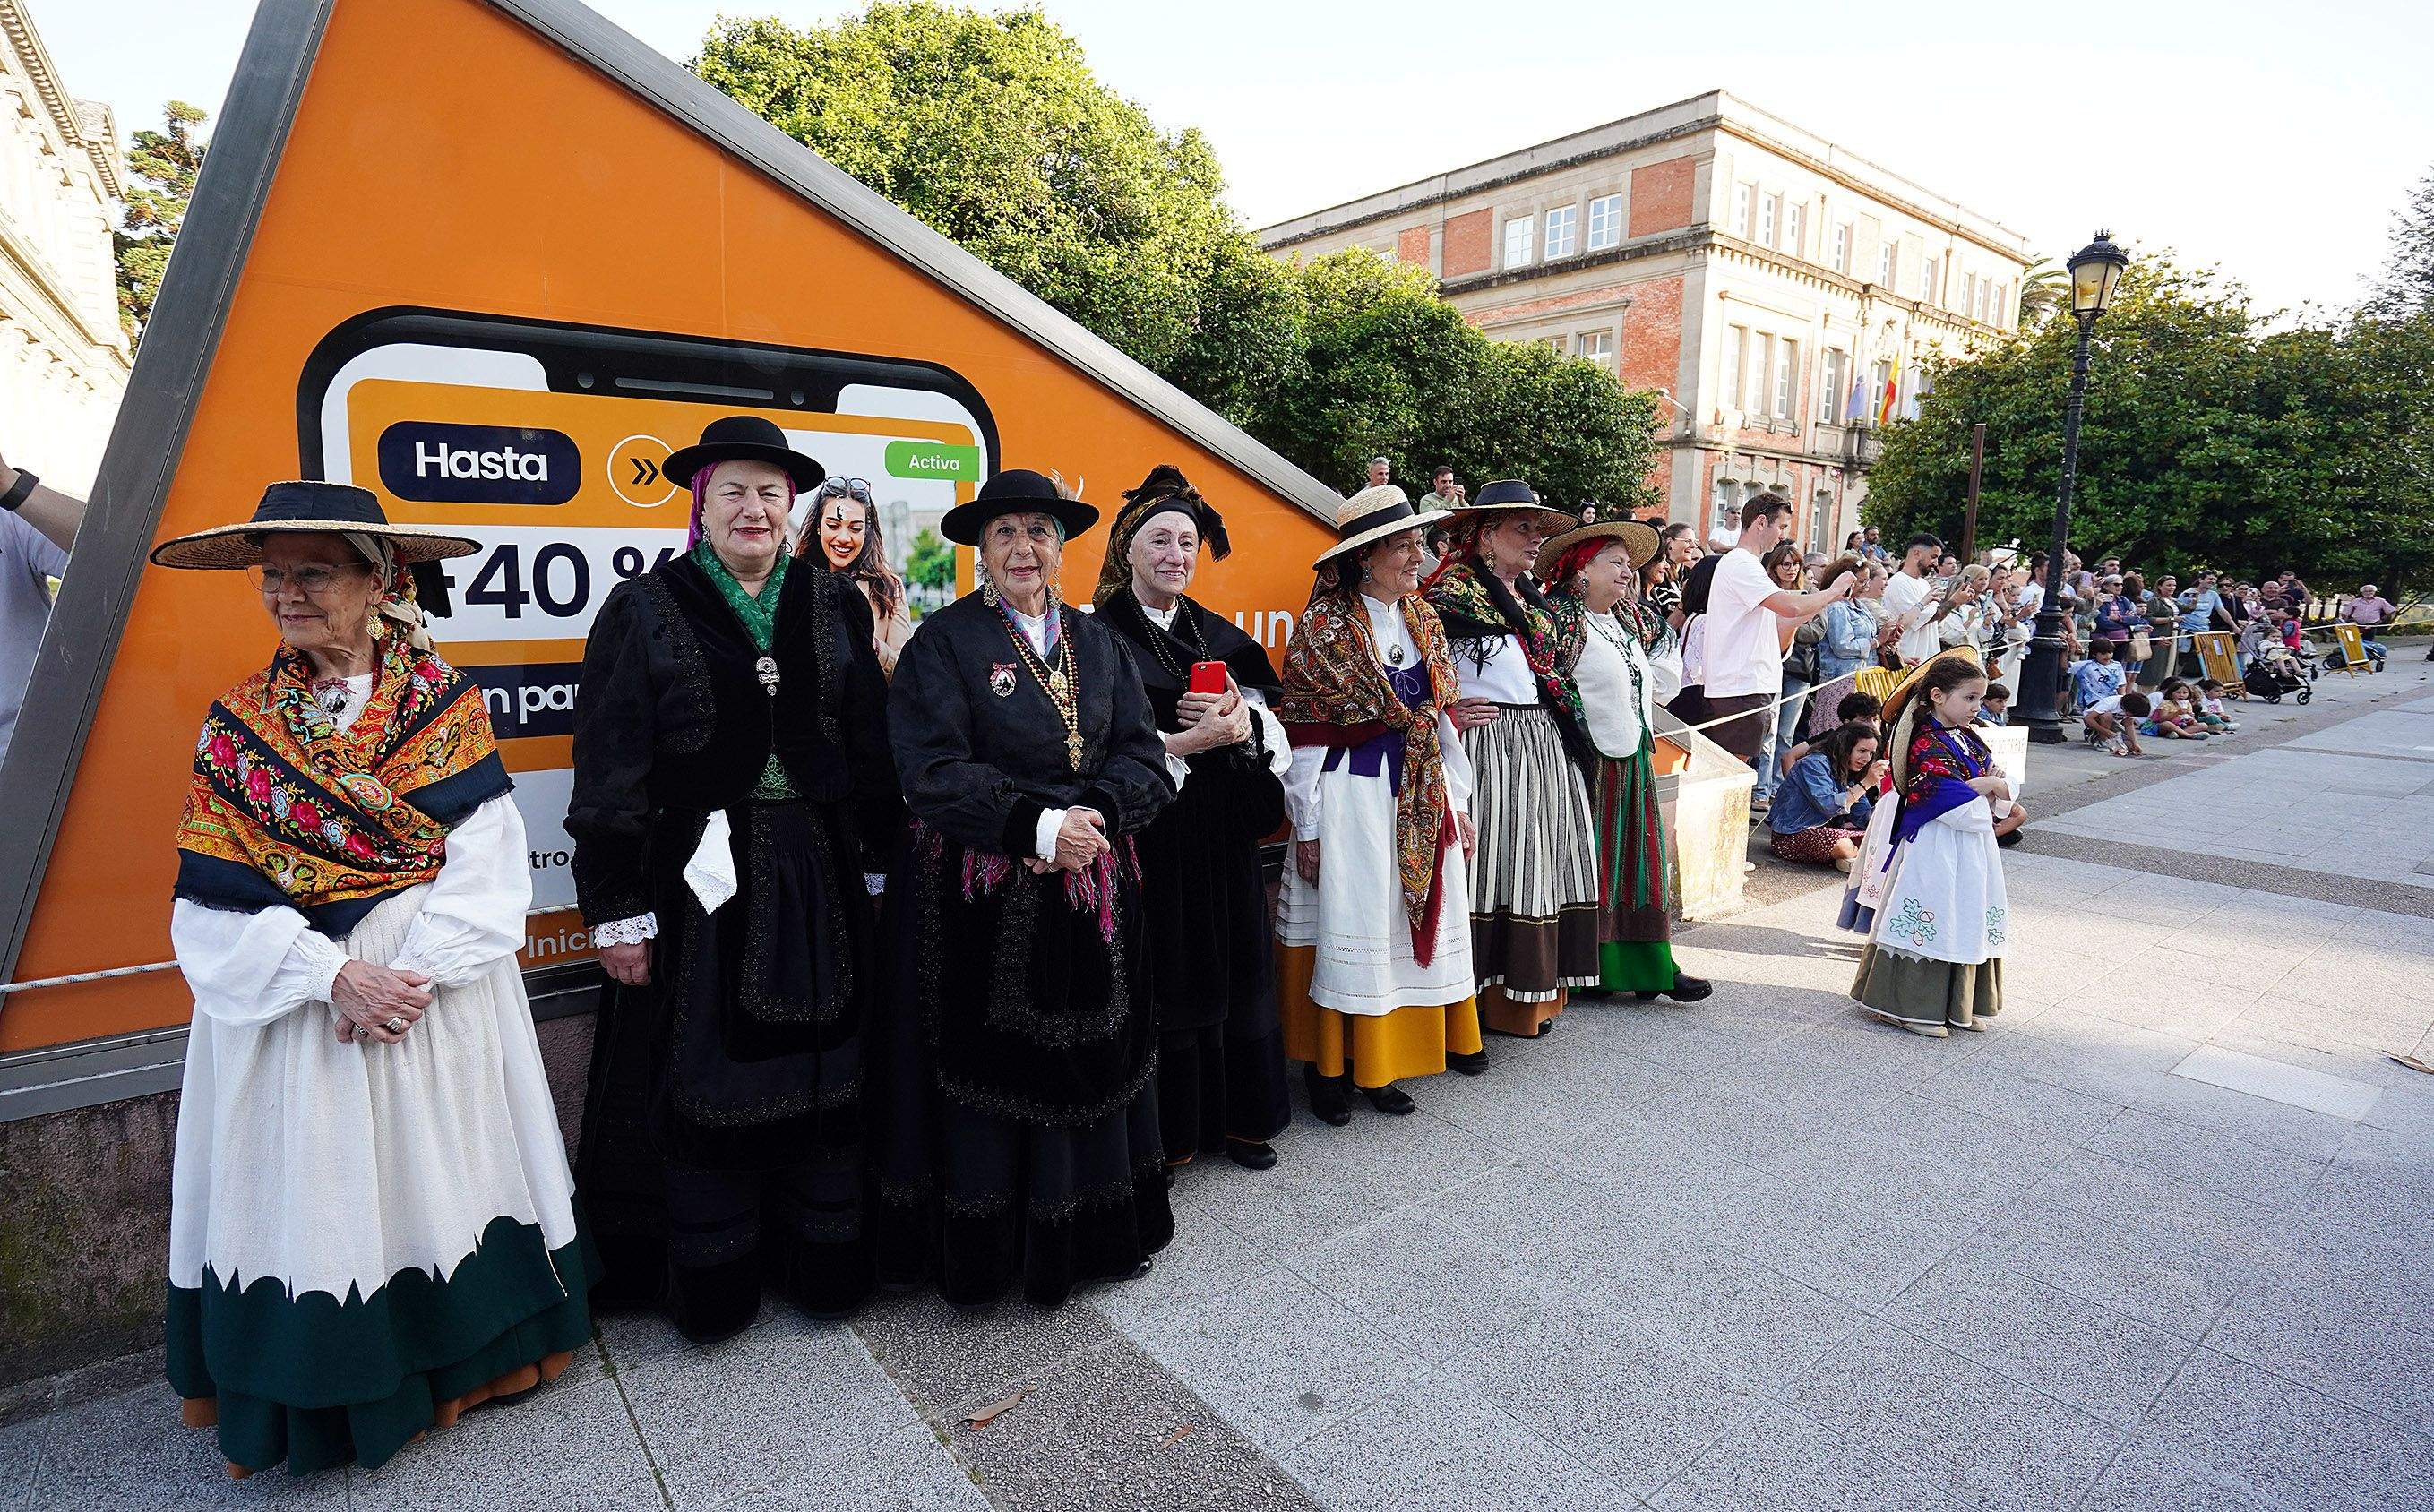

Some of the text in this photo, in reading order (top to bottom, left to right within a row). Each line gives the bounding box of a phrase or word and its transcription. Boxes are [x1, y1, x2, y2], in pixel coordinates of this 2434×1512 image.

[415, 441, 548, 482] Hasta
[908, 454, 959, 471] Activa
[518, 683, 580, 725] pa
[529, 850, 569, 869] tro
